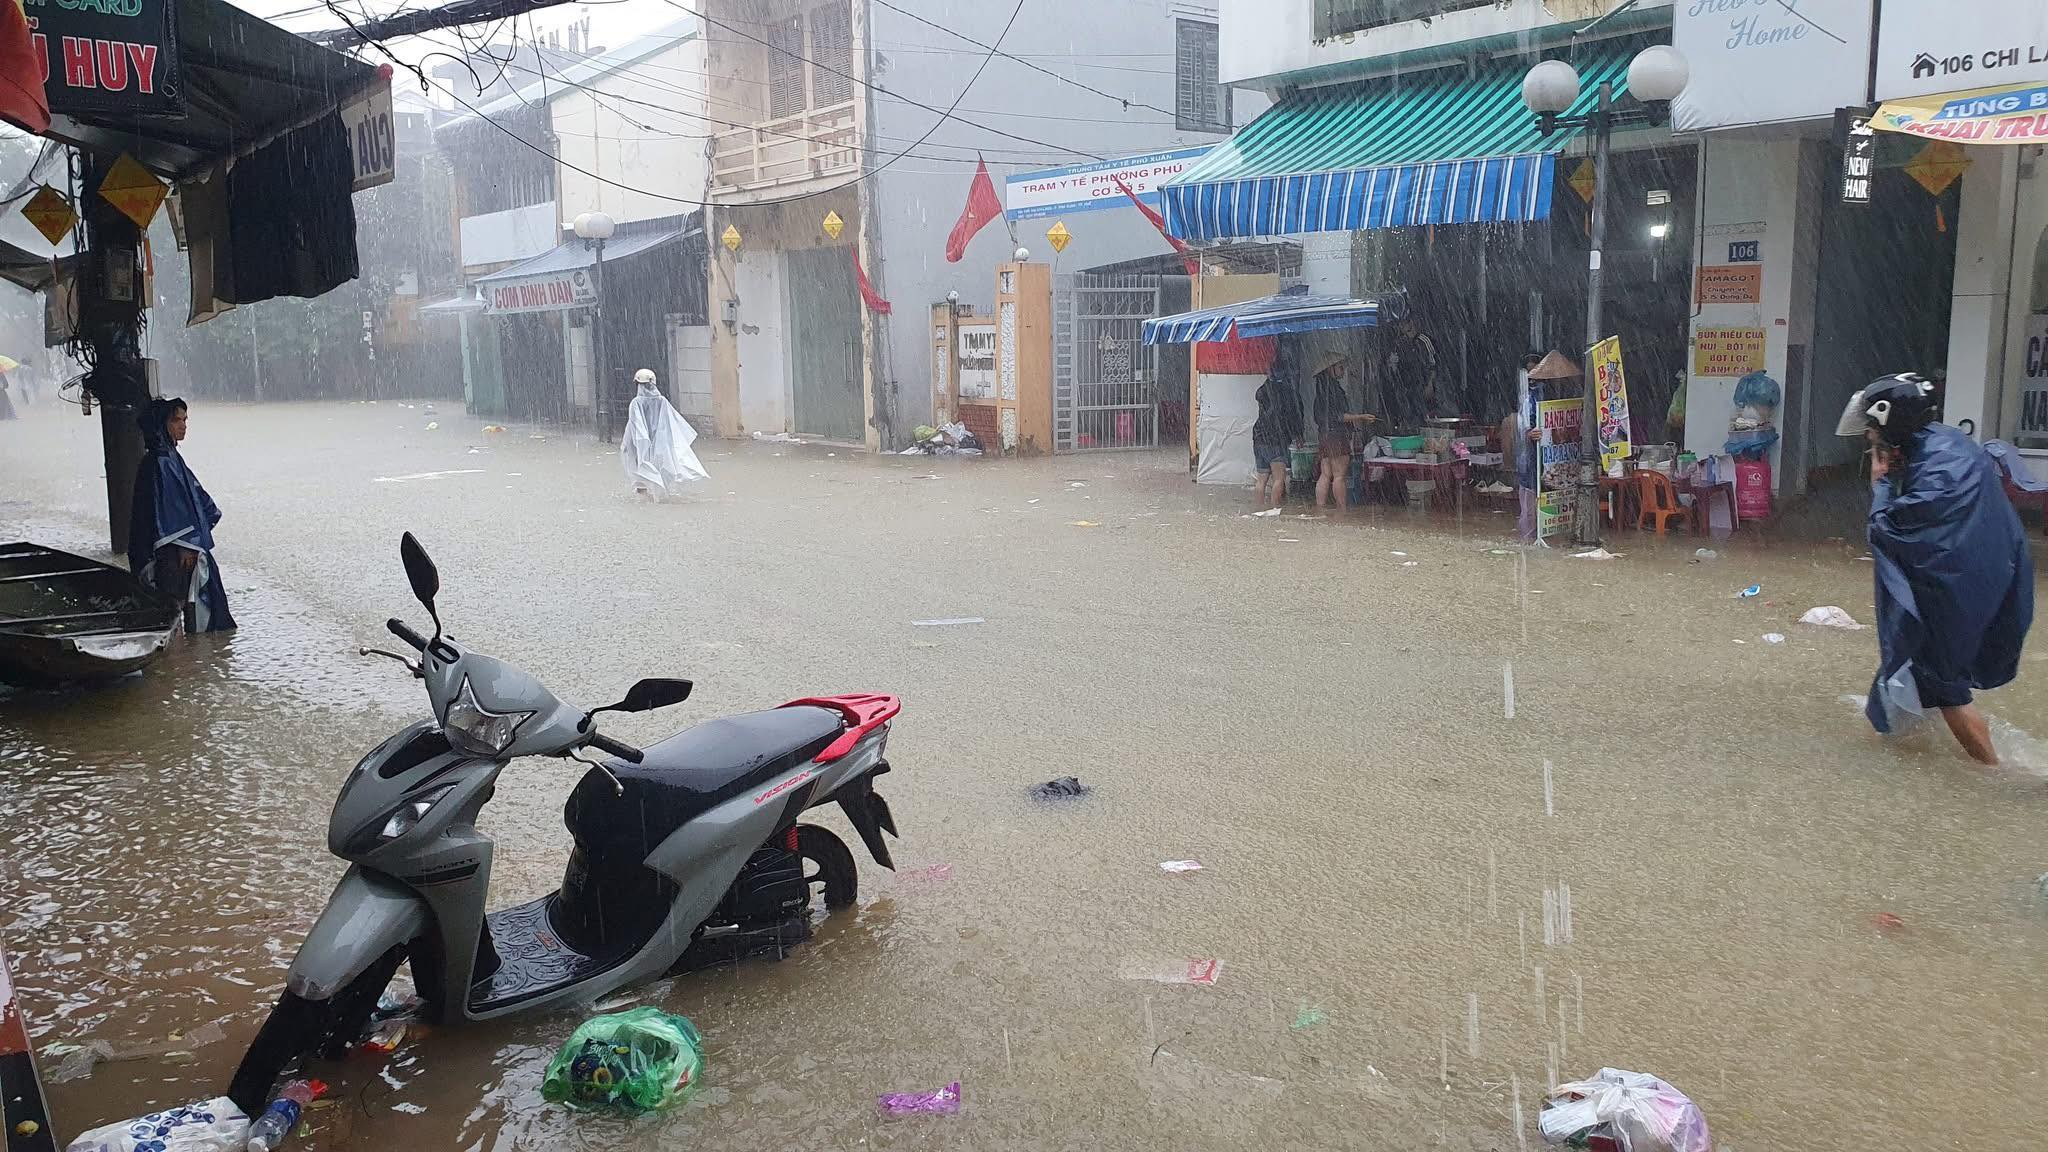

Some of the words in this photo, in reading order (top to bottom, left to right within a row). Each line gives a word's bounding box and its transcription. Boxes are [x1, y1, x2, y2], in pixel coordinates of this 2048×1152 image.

[1726, 15, 1808, 49] Home
[62, 36, 158, 94] HUY
[1940, 54, 1974, 75] 106
[1981, 47, 2020, 69] CHI
[1022, 182, 1057, 196] TRẠM
[1060, 180, 1068, 189] Y
[1071, 174, 1088, 188] TẾ
[1091, 168, 1149, 185] PHƯỜNG
[1153, 162, 1184, 178] PHÚ
[1847, 156, 1871, 177] NEW
[1137, 182, 1146, 192] 5
[1844, 178, 1869, 199] HAIR
[1731, 244, 1755, 259] 106
[494, 285, 520, 309] CƠM
[753, 769, 811, 805] VISION
